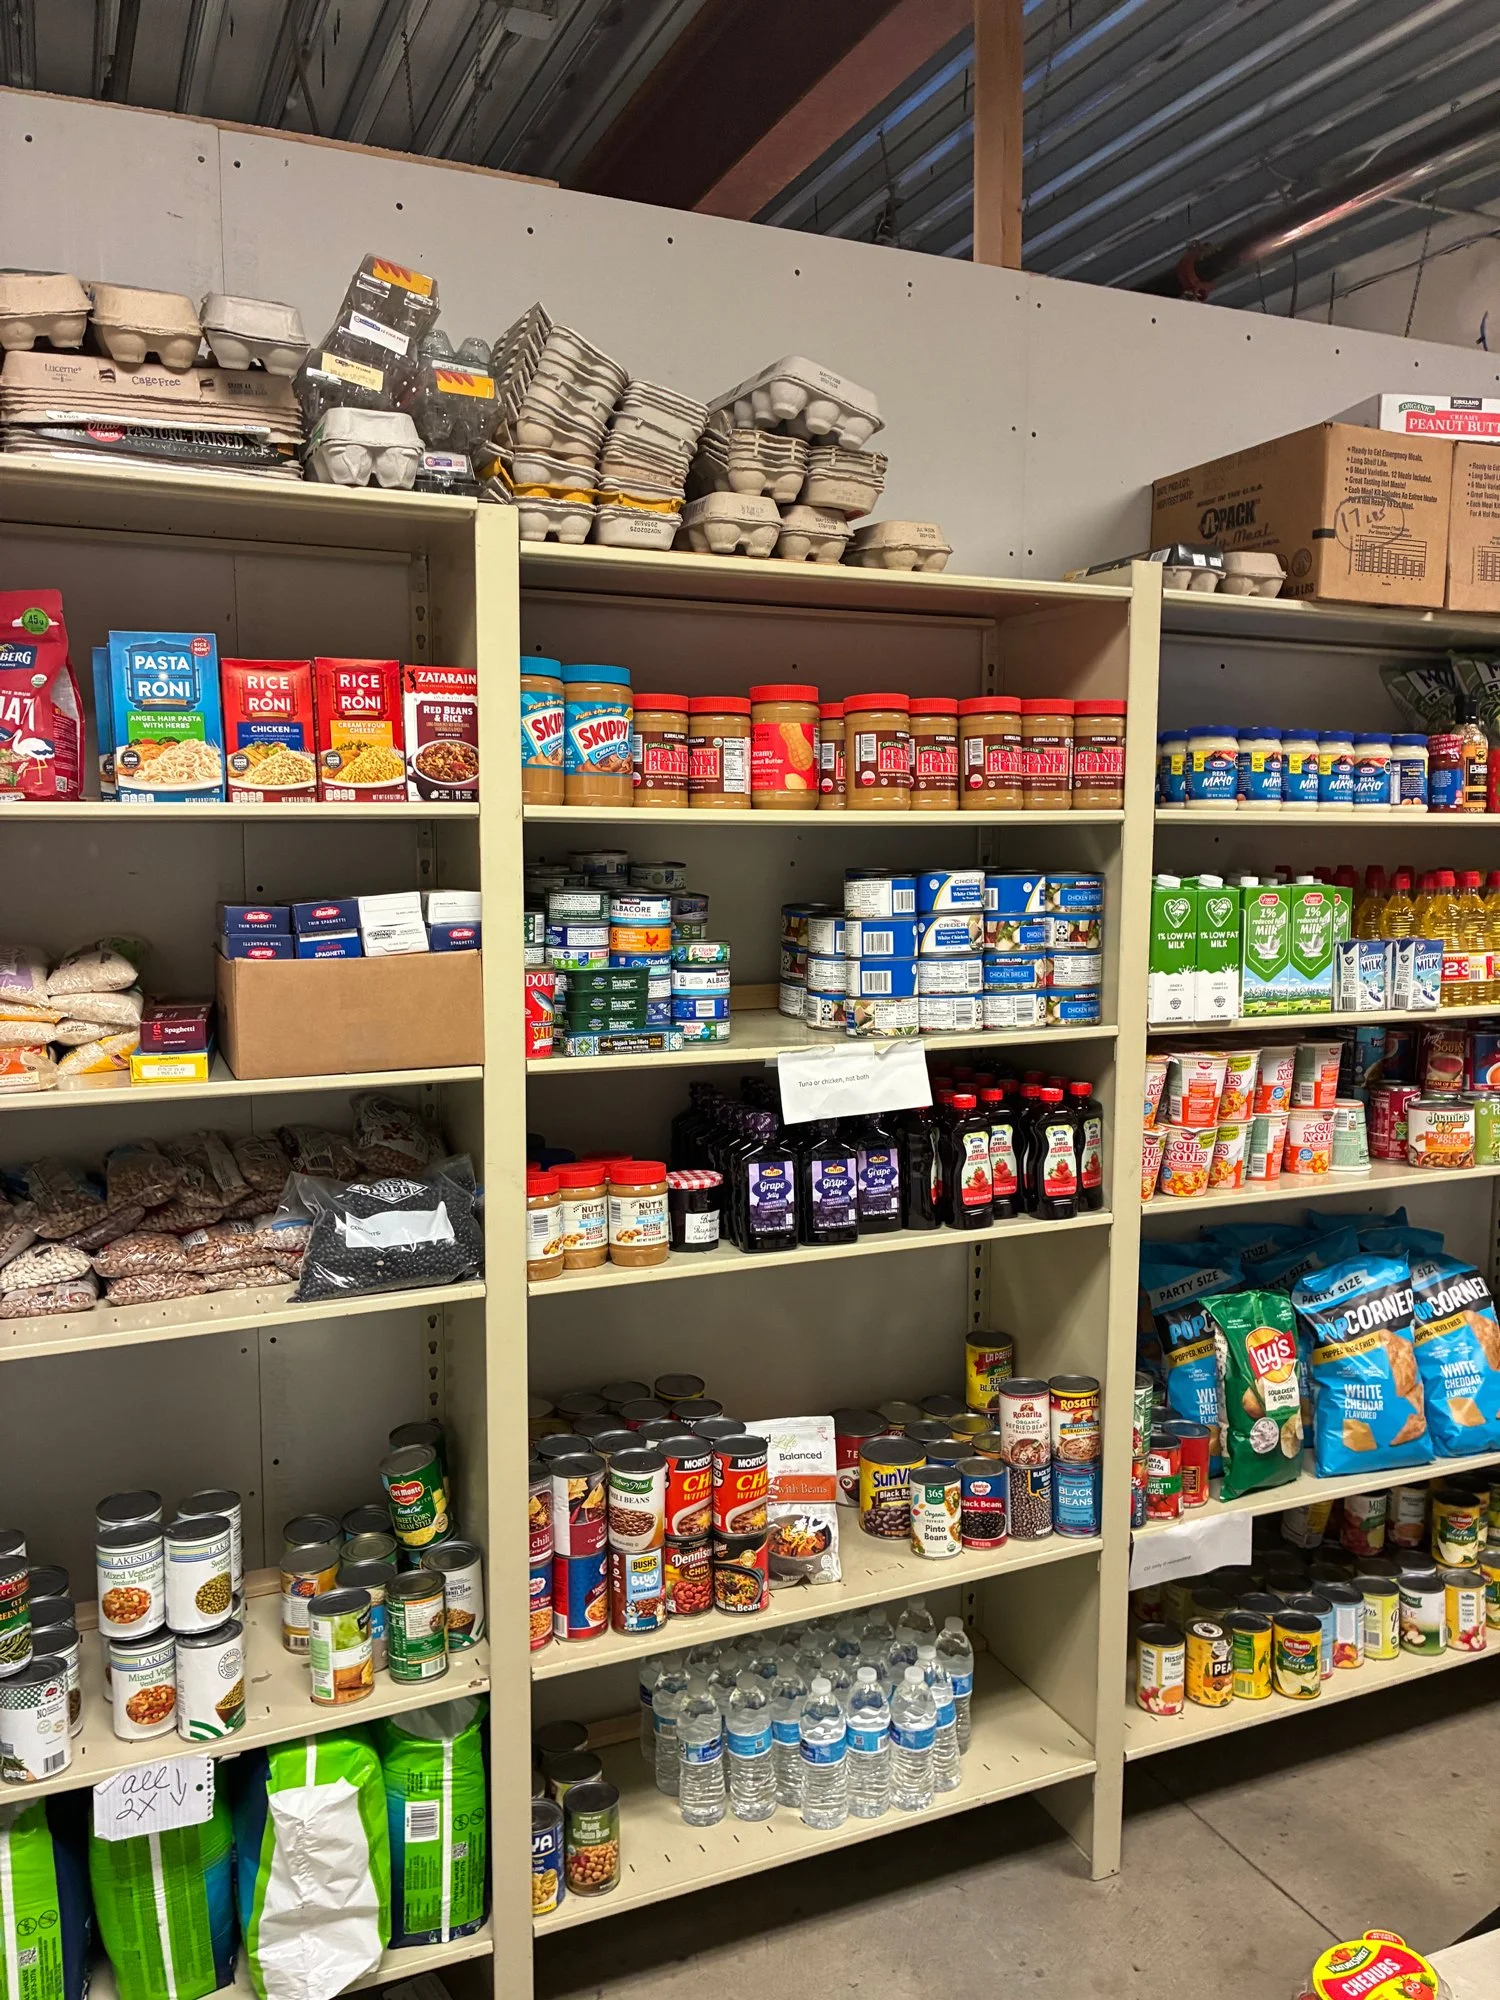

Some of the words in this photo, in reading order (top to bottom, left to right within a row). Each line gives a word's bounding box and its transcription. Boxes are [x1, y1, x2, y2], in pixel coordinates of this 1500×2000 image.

[44, 363, 79, 375] Lucerne
[1401, 403, 1432, 413] ORGANIC
[1409, 418, 1464, 431] PEANUT
[126, 426, 243, 449] PASTURE-RAISED
[1351, 446, 1367, 456] Ready
[1382, 449, 1408, 461] Emergency
[1350, 457, 1363, 465] Long
[134, 655, 190, 671] PASTA
[247, 676, 289, 690] RICE
[340, 674, 380, 688] RICE
[138, 681, 191, 697] RONI
[249, 698, 291, 711] RONI
[341, 696, 381, 710] RONI
[423, 705, 442, 715] RED
[443, 706, 473, 716] BEANS
[575, 711, 593, 720] FUEL
[434, 714, 441, 722] &
[442, 714, 463, 723] RICE
[251, 725, 290, 733] CHICKEN
[578, 719, 628, 750] SKIPPY
[595, 745, 616, 758] CREAMY
[1077, 753, 1123, 763] PEANUT
[1077, 763, 1123, 773] BUTTER
[1202, 776, 1233, 788] MAYO
[1354, 781, 1384, 792] MAYO
[246, 913, 269, 921] Barilla
[315, 908, 338, 917] Barilla
[1260, 908, 1276, 917] 1%
[1305, 907, 1321, 917] 1%
[451, 930, 473, 938] Barilla
[1209, 931, 1225, 939] LOW
[1226, 930, 1239, 938] FAT
[1255, 925, 1278, 936] Milk
[1300, 924, 1323, 935] Milk
[1157, 932, 1166, 940] 1%
[1167, 932, 1183, 940] LOW
[1184, 931, 1196, 940] FAT
[1167, 941, 1185, 949] MILK
[1210, 940, 1228, 948] MILK
[314, 949, 346, 958] SPAGHETTI
[1361, 961, 1382, 973] MILK
[1416, 959, 1438, 972] MILK
[164, 1025, 195, 1035] Spaghetti
[1433, 1042, 1464, 1053] SOUPS
[821, 1077, 845, 1085] chicken,
[1426, 1112, 1470, 1123] Juanita's
[1173, 1141, 1201, 1153] CUP
[867, 1167, 891, 1178] Grape
[759, 1181, 785, 1192] Grape
[822, 1177, 848, 1189] Grape
[360, 1184, 416, 1196] STREET
[828, 1188, 842, 1196] Jelly
[581, 1203, 605, 1213] NUT'N
[638, 1200, 663, 1210] NUT'N
[582, 1211, 604, 1220] BETTER
[639, 1207, 663, 1216] BETTER
[1289, 1260, 1314, 1280] SIZE
[1158, 1280, 1194, 1301] PARTY
[1196, 1270, 1220, 1288] SIZE
[1302, 1289, 1335, 1305] PARTY
[1337, 1275, 1362, 1293] SIZE
[1359, 1338, 1376, 1349] FRIED
[985, 1352, 994, 1362] LA
[1250, 1336, 1293, 1374] Lay's
[1440, 1360, 1478, 1379] WHITE
[1444, 1375, 1482, 1390] CHEDDAR
[1277, 1393, 1294, 1401] ONION
[1344, 1384, 1383, 1400] WHITE
[1445, 1386, 1478, 1398] FLAVORED
[1344, 1400, 1384, 1411] CHEDDAR
[1012, 1410, 1042, 1419] Rosarita
[1344, 1410, 1377, 1420] FLAVORED
[779, 1451, 823, 1461] Balanced
[391, 1489, 400, 1497] Del
[400, 1485, 422, 1496] Monte
[779, 1484, 799, 1493] with
[801, 1484, 828, 1493] Beans
[926, 1489, 943, 1498] 365
[1058, 1487, 1092, 1496] BLACK
[624, 1496, 650, 1504] BEANS
[684, 1490, 704, 1501] WITH
[737, 1489, 757, 1500] WITH
[879, 1490, 898, 1499] Black
[1058, 1497, 1093, 1506] BEANS
[412, 1512, 431, 1522] CORN
[924, 1510, 947, 1519] Organic
[415, 1518, 432, 1529] STYLE
[925, 1524, 946, 1533] Pinto
[531, 1533, 551, 1549] chili
[924, 1532, 948, 1541] Beans
[111, 1550, 156, 1566] LAKESIDE
[632, 1558, 658, 1571] BUSH'S
[103, 1569, 126, 1580] Mixed
[737, 1602, 761, 1613] Beans
[1294, 1642, 1311, 1650] Monte
[1300, 1662, 1315, 1670] Pears
[128, 1671, 154, 1683] Mixed
[36, 1708, 47, 1720] NO
[122, 1765, 171, 1794] all
[116, 1793, 157, 1821] 2X
[581, 1820, 600, 1832] Organic
[1341, 1958, 1401, 1997] CHERUBS
